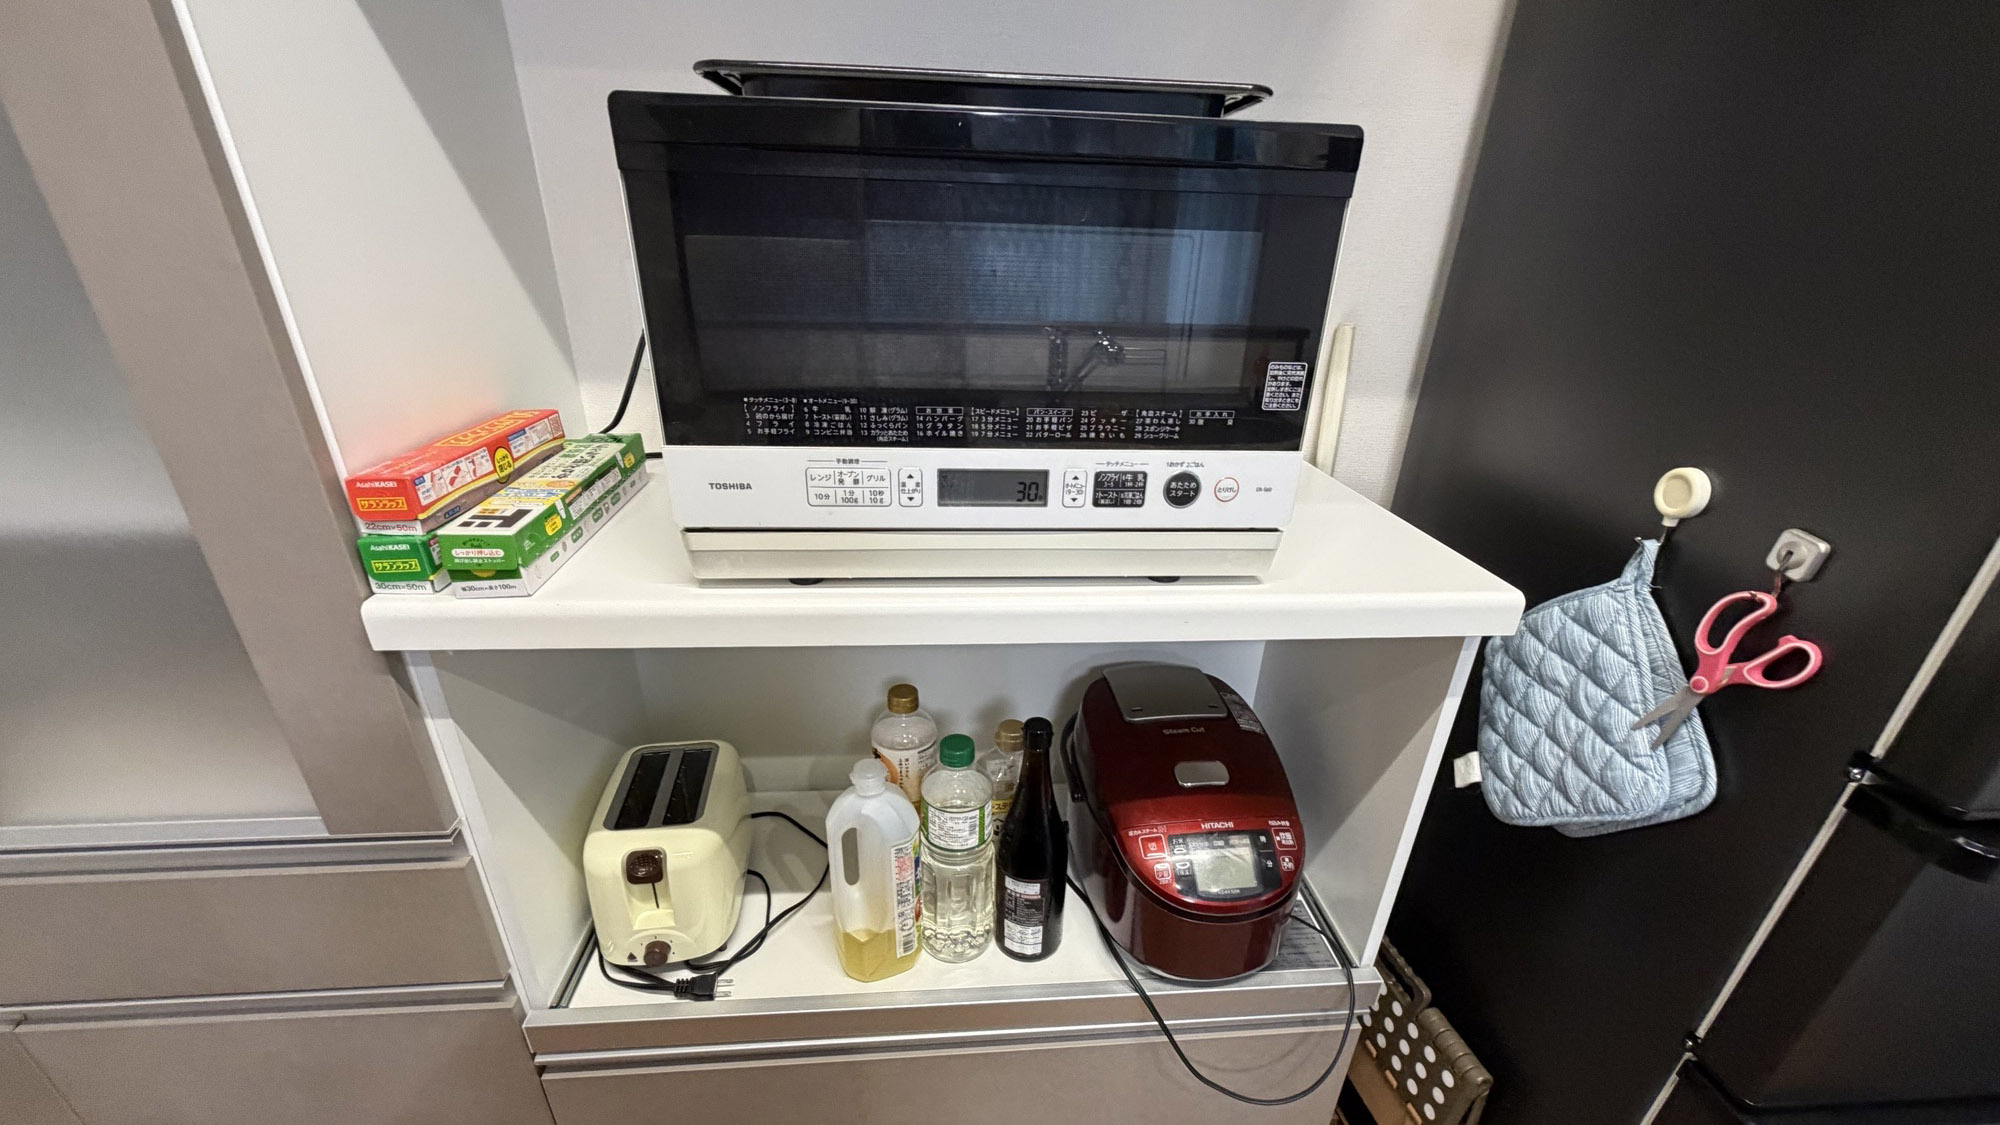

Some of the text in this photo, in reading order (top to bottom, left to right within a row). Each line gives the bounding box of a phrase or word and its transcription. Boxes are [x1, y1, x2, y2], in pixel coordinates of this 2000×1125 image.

[810, 473, 832, 482] レンジ
[836, 470, 860, 478] オーブン
[866, 474, 886, 482] グリル
[1097, 473, 1120, 481] ノンフライ
[356, 480, 397, 488] AsahiKASEI
[708, 482, 752, 490] TOSHIBA
[1169, 481, 1197, 489] あたため
[814, 492, 831, 501] 10分
[843, 489, 855, 497] 1分
[1169, 489, 1196, 497] スタート
[359, 499, 406, 509] サランラップ
[841, 496, 859, 504] 100g
[365, 522, 418, 532] 22cm×50m
[374, 560, 419, 571] サランラップ
[375, 582, 427, 591] 30cm×50m
[1162, 727, 1190, 735] Steam
[1200, 821, 1235, 830] HITACHI
